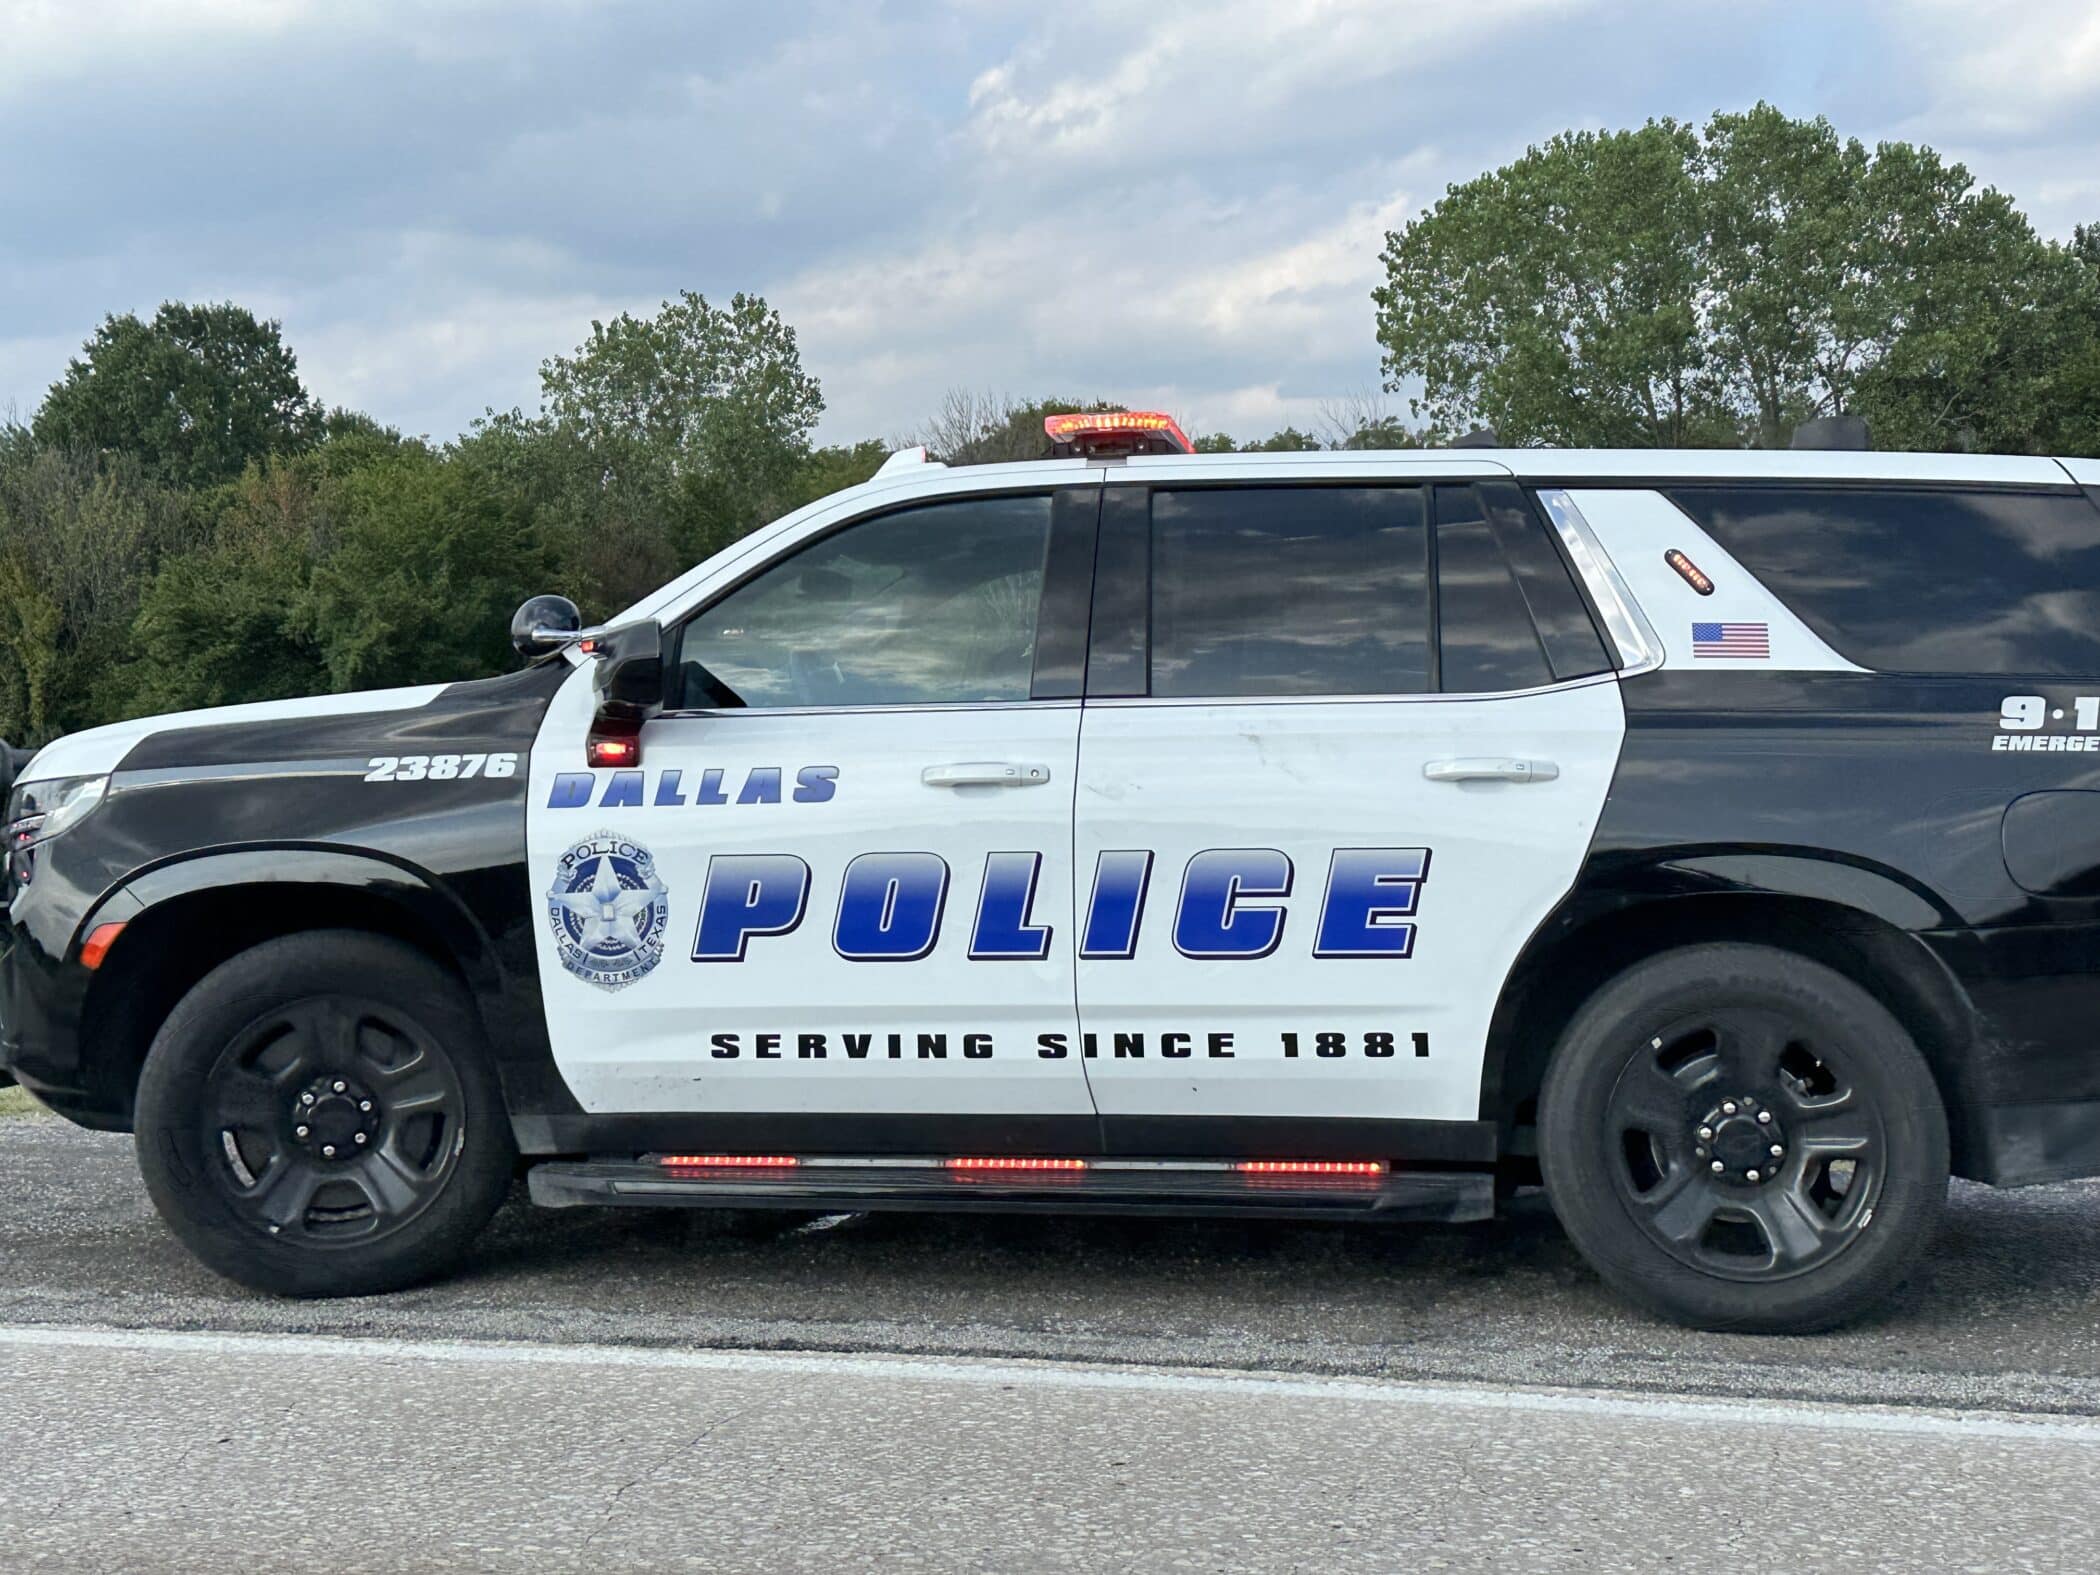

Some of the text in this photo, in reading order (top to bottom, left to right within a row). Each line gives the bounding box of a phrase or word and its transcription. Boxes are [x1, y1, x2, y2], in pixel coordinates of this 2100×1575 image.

[363, 752, 518, 783] 23876
[546, 765, 840, 809] DALLAS
[561, 841, 649, 870] POLICE
[691, 847, 1432, 962] POLICE
[551, 907, 583, 960] DALLAS
[640, 905, 666, 955] TEXAS
[566, 957, 660, 982] DEPARTMENT
[710, 1031, 1431, 1061] SERVING SINCE 1881
